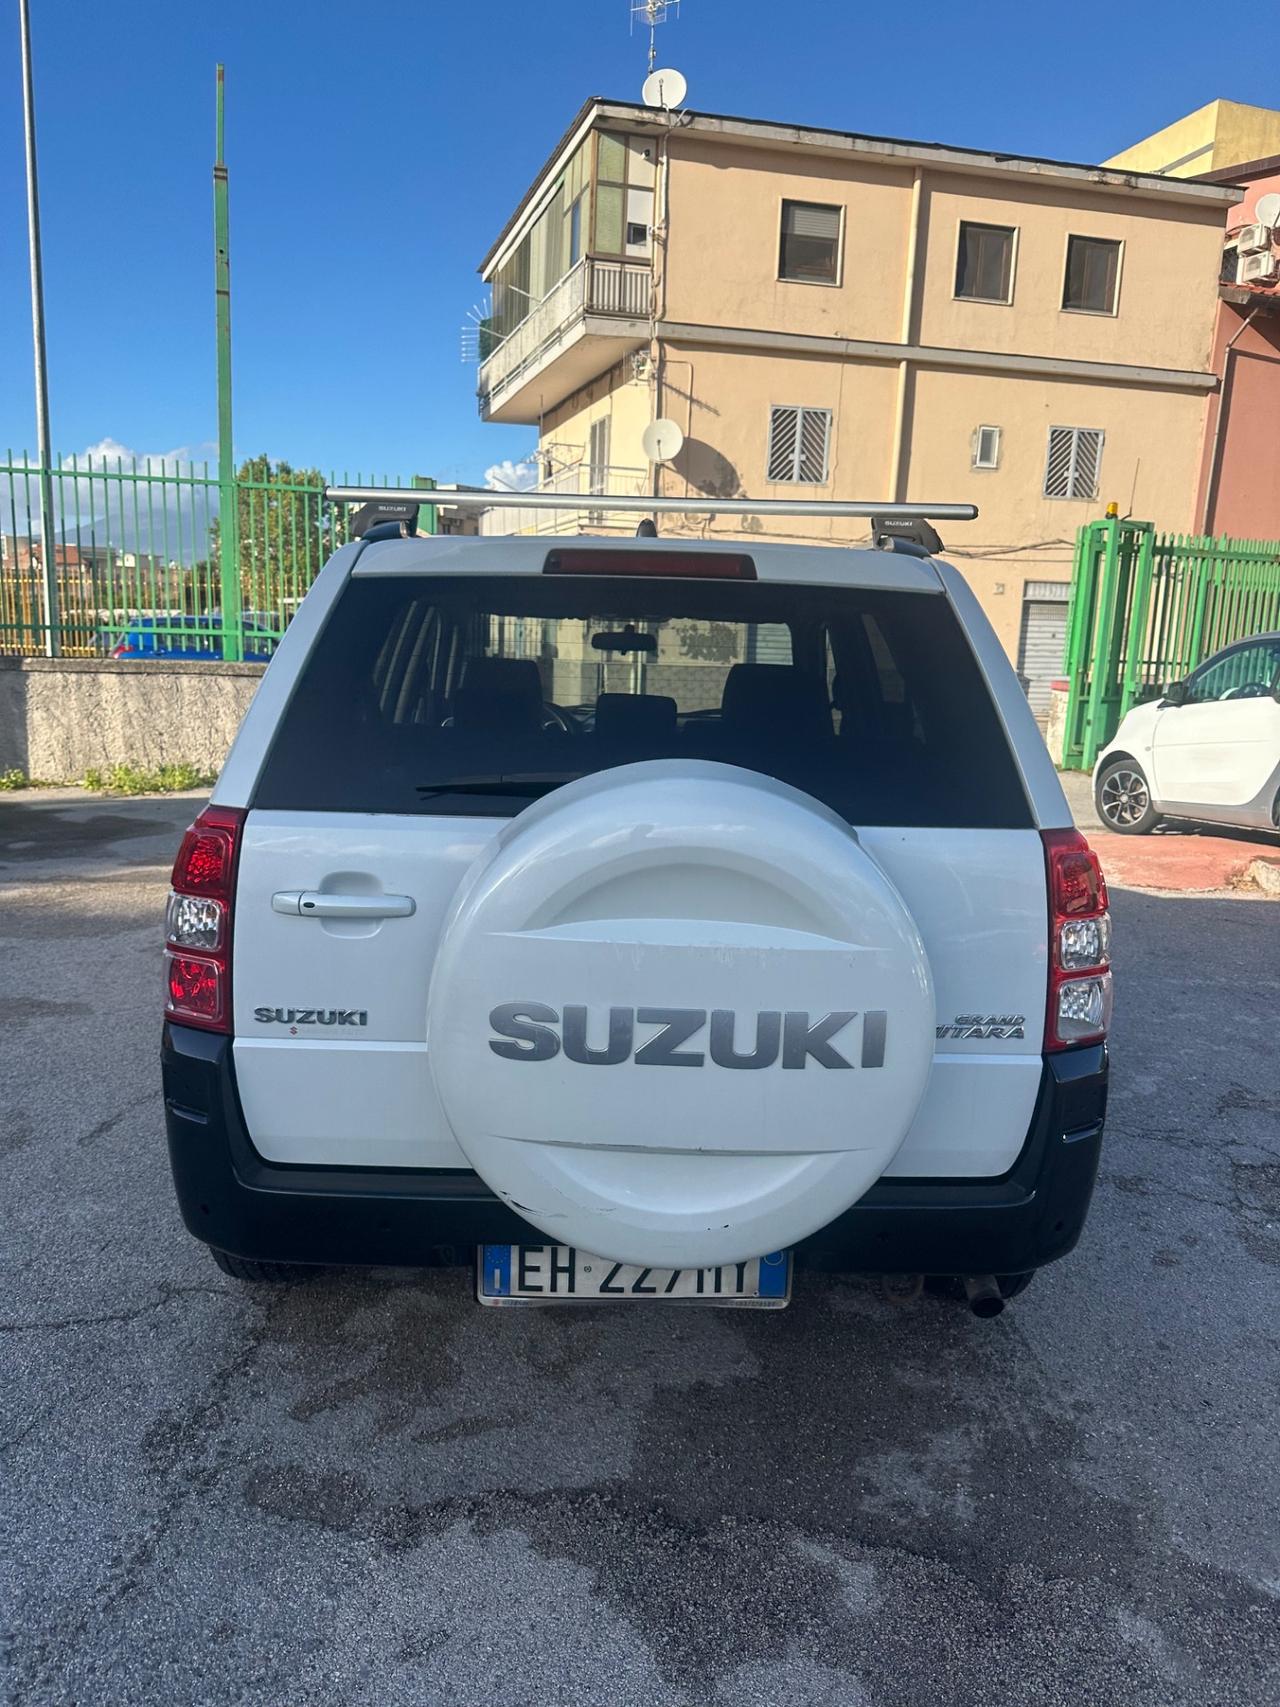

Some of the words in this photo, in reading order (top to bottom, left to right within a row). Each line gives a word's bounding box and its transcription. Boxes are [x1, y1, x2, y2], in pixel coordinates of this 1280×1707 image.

[254, 1007, 368, 1026] SUZUKI
[955, 1014, 1026, 1026] GRAND
[488, 1001, 888, 1070] SUZUKI
[936, 1024, 1025, 1039] ITARA
[518, 1246, 576, 1293] EH
